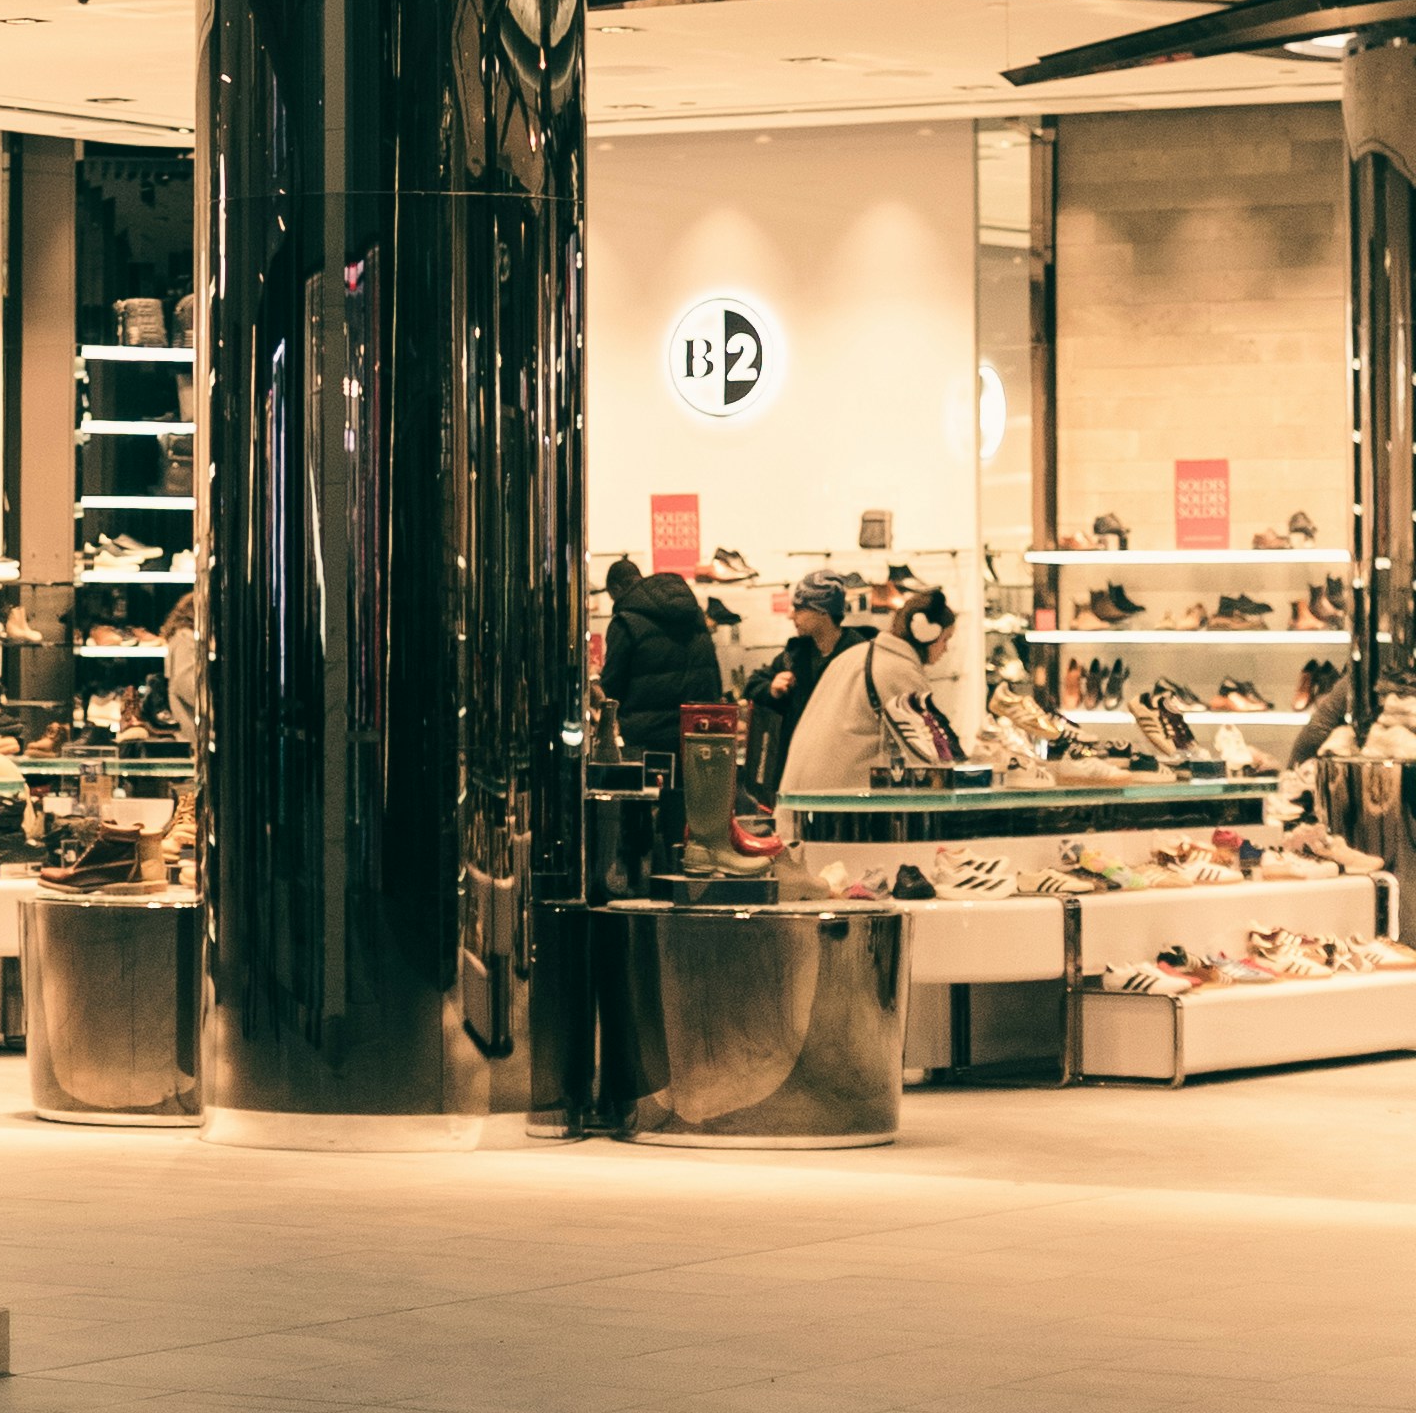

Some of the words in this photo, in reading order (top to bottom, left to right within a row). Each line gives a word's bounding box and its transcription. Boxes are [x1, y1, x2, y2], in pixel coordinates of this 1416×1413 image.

[682, 332, 758, 381] B2
[1178, 479, 1226, 492] SOLDES
[1178, 493, 1226, 505] SOLDES
[1178, 506, 1226, 518] SOLDES
